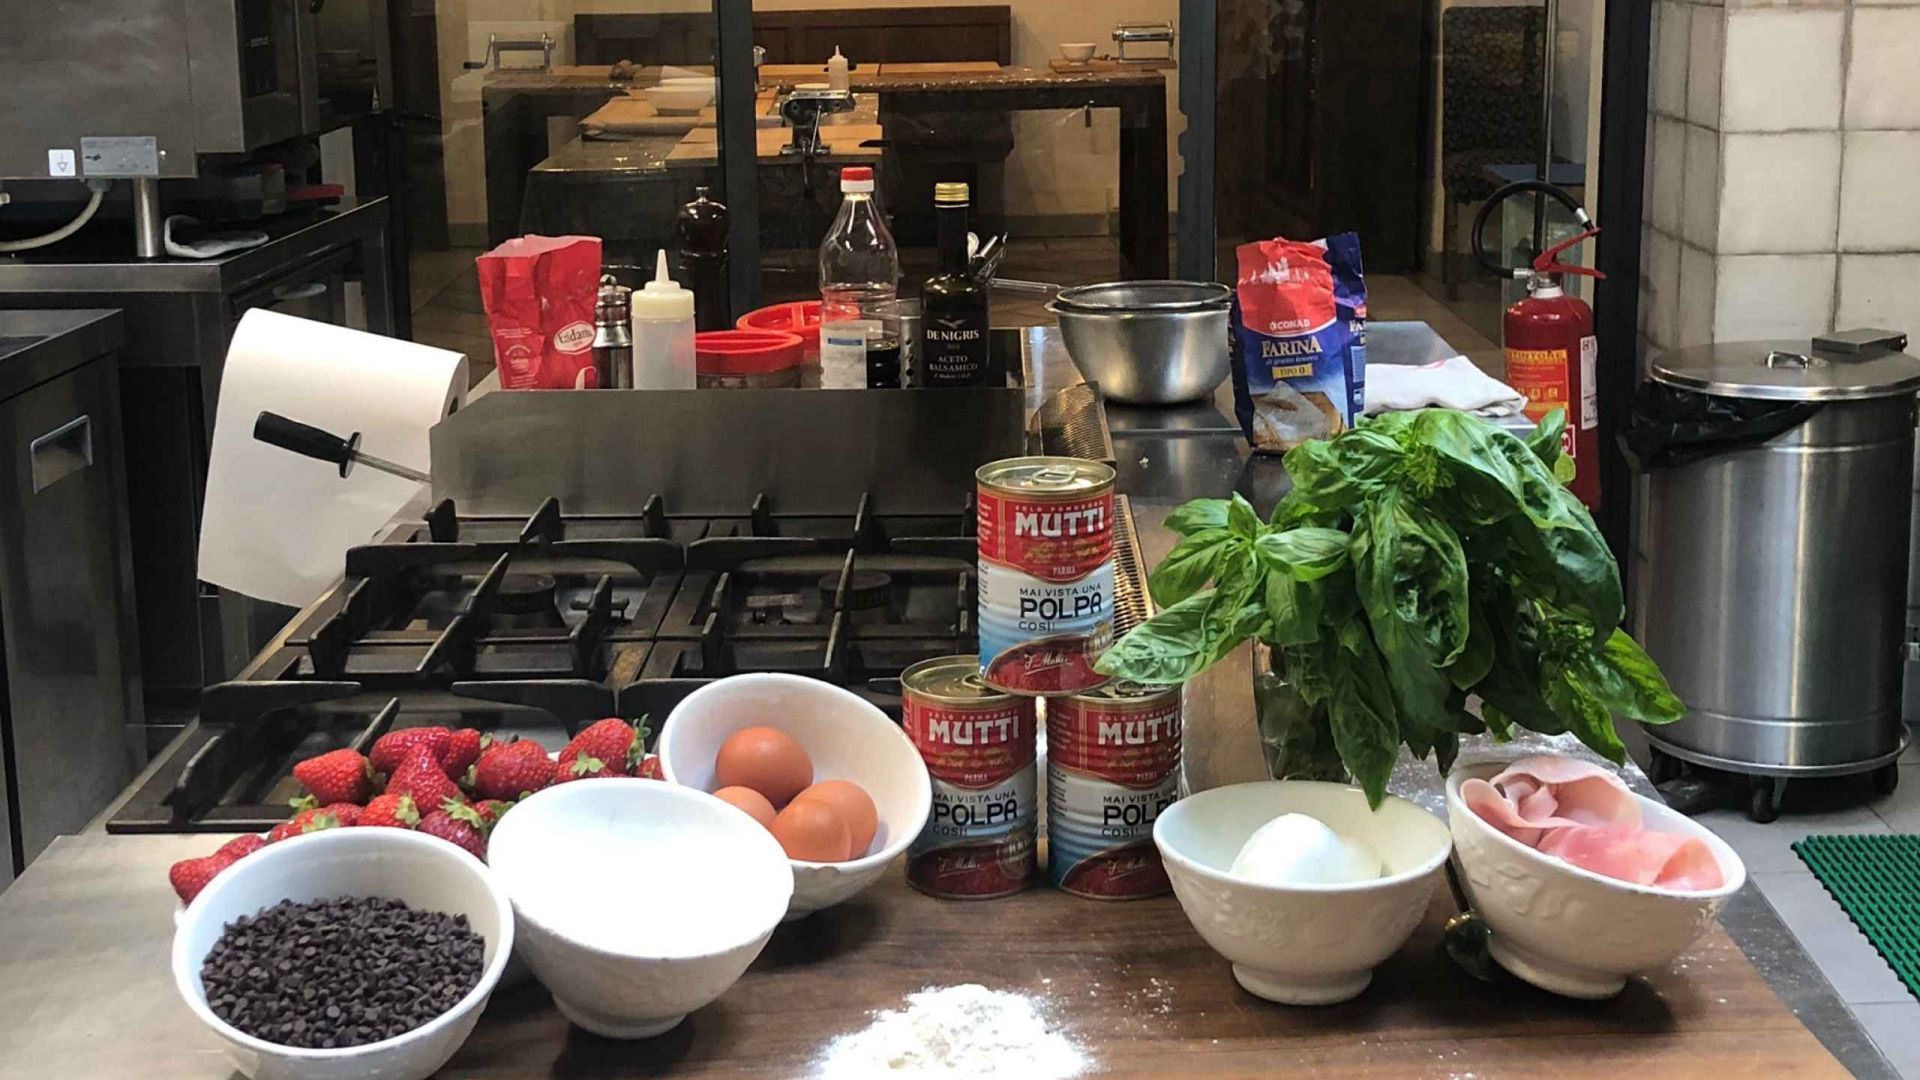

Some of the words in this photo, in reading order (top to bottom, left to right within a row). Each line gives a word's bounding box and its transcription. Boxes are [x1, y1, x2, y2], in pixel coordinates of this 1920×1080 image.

[1277, 319, 1310, 330] CONAD
[927, 330, 939, 340] DE
[941, 329, 980, 341] NIGRIS
[1262, 335, 1323, 358] FARINA
[938, 355, 968, 363] ACETO
[1280, 368, 1297, 377] TIPO
[1015, 506, 1104, 537] MUTTI
[1020, 588, 1041, 596] MAI
[1045, 588, 1079, 597] VISTA
[1082, 582, 1102, 594] UNA
[1020, 592, 1102, 620] POLPA
[928, 715, 1019, 745] MUTTI
[1098, 710, 1180, 745] MUTTI
[934, 793, 953, 802] MAI
[957, 794, 991, 804] VISTA
[995, 789, 1017, 800] UNA
[1104, 796, 1125, 804] MAI
[934, 799, 1017, 826] POLPA
